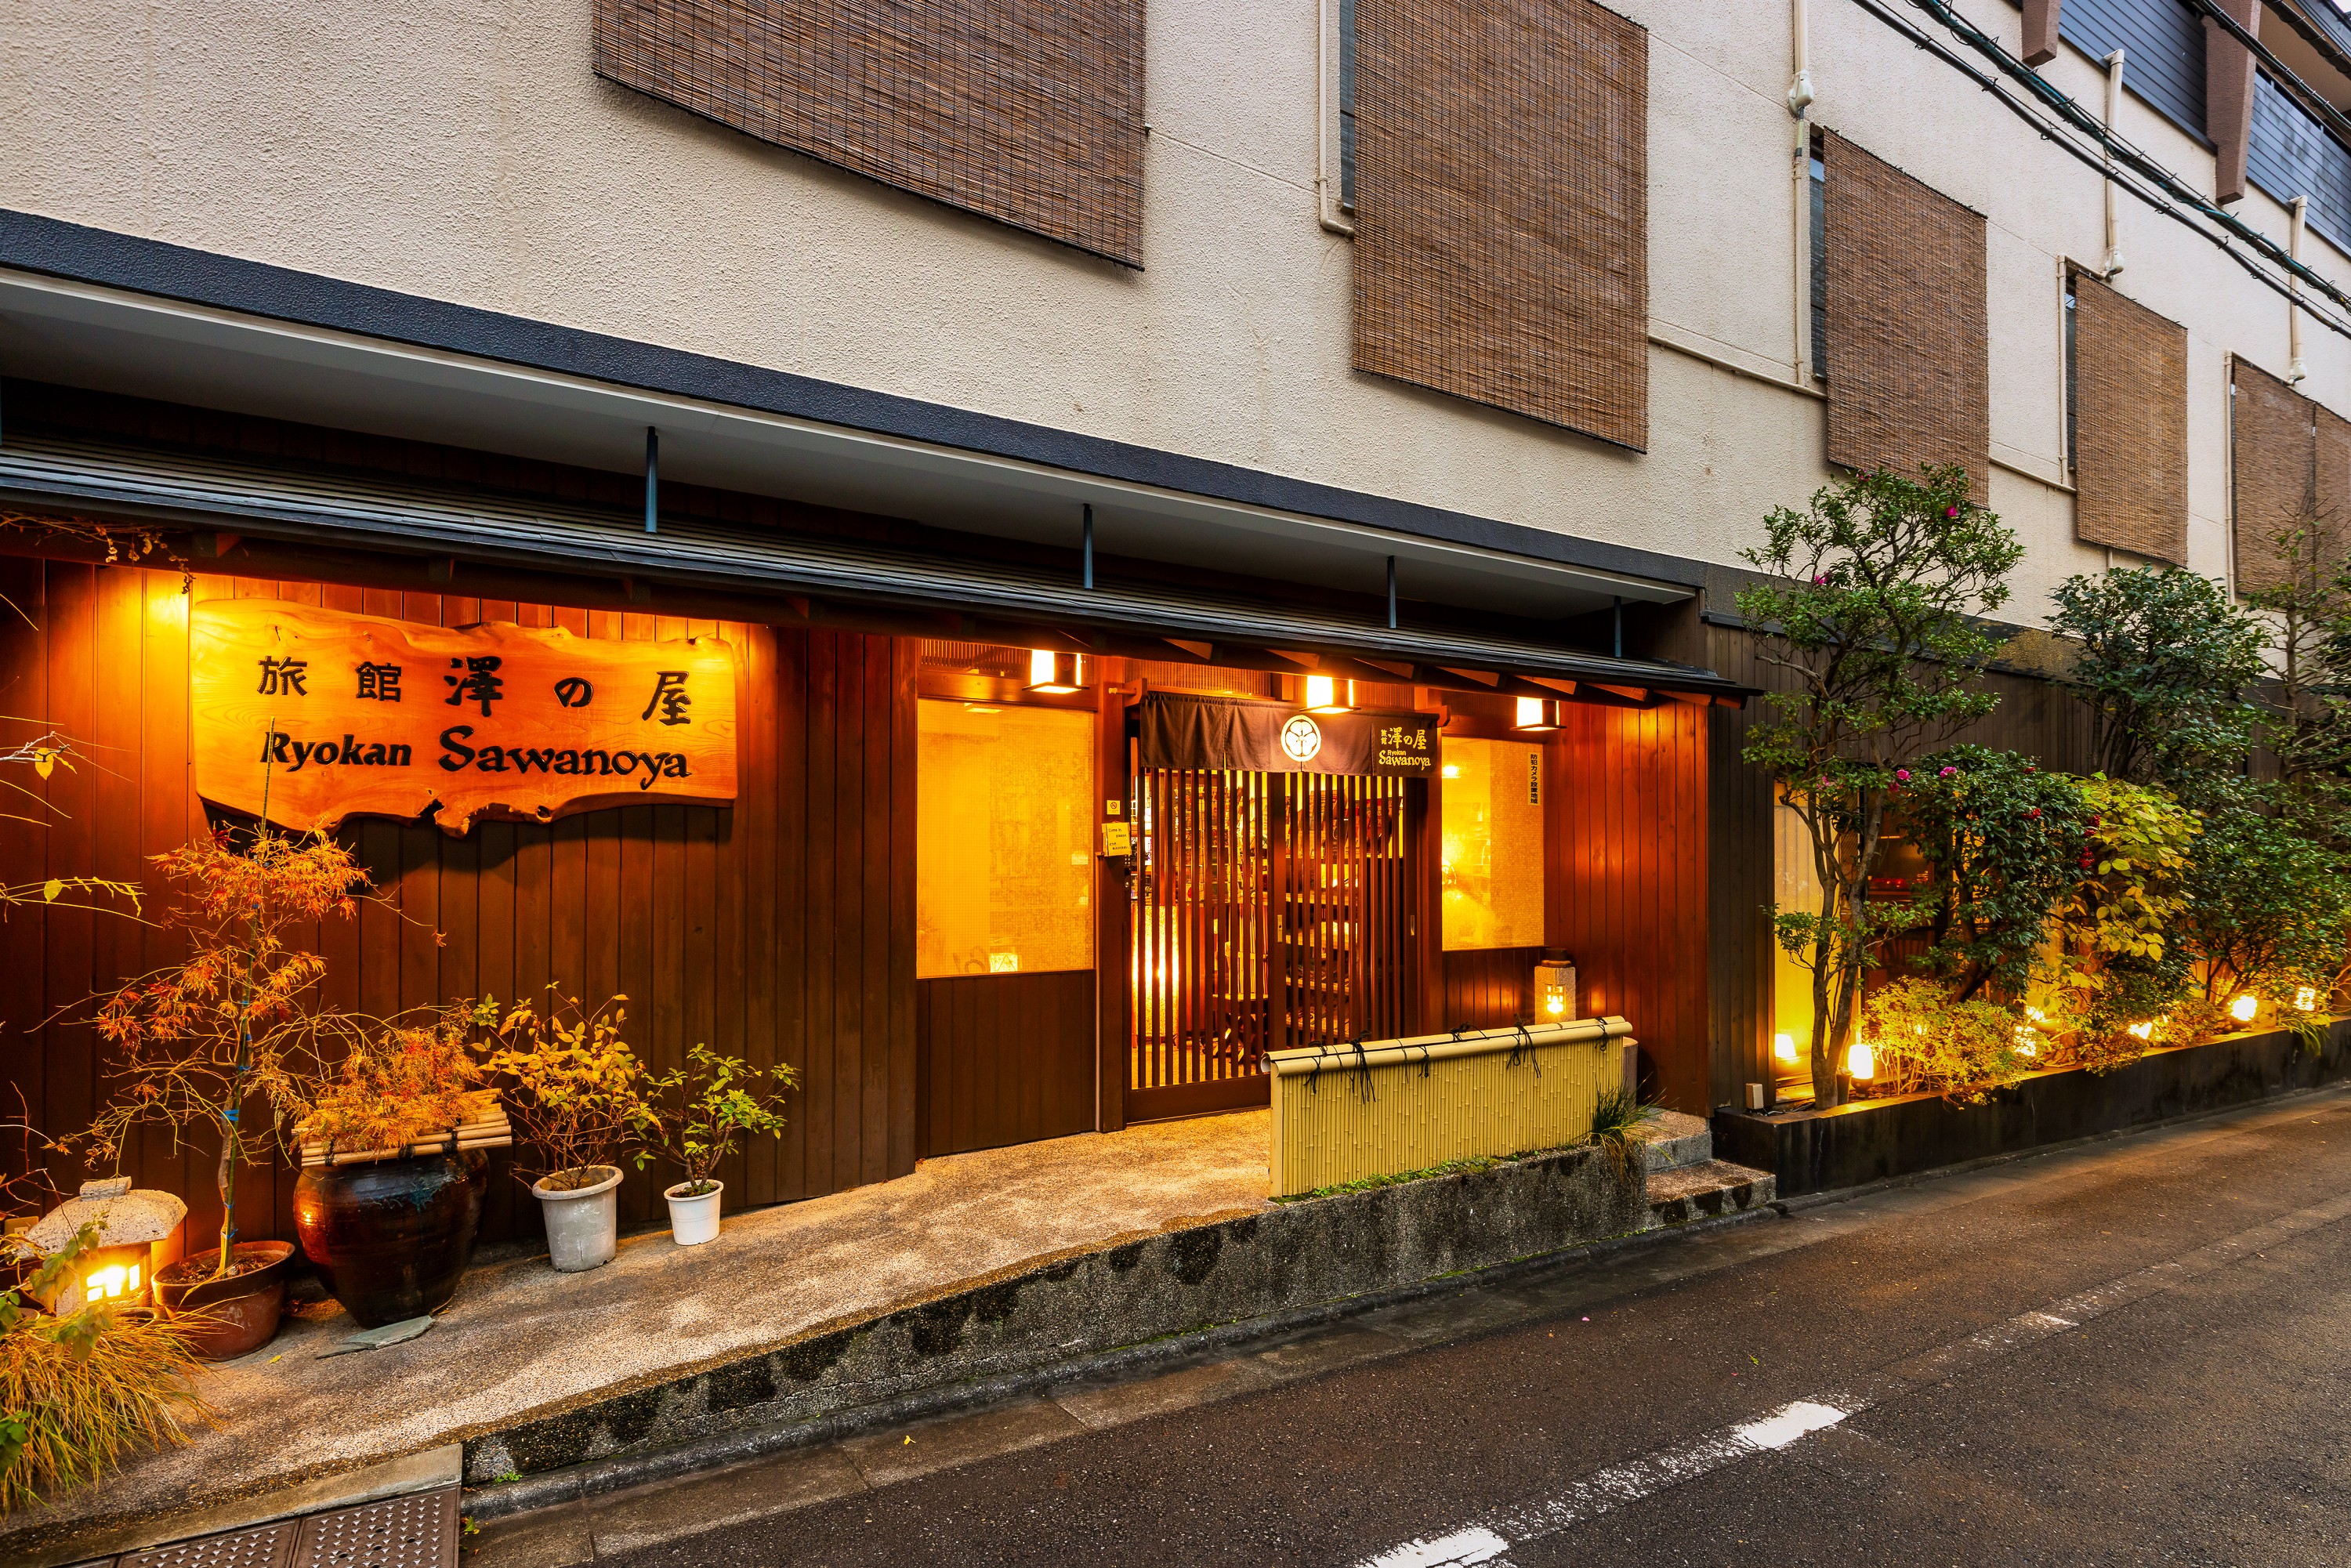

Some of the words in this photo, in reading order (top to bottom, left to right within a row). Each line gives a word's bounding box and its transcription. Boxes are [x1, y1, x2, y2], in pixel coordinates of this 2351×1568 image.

[1387, 726, 1427, 750] 澤の屋
[259, 731, 412, 773] Ryokan
[437, 725, 693, 791] Sawanoya
[1378, 749, 1432, 771] Sawanoya
